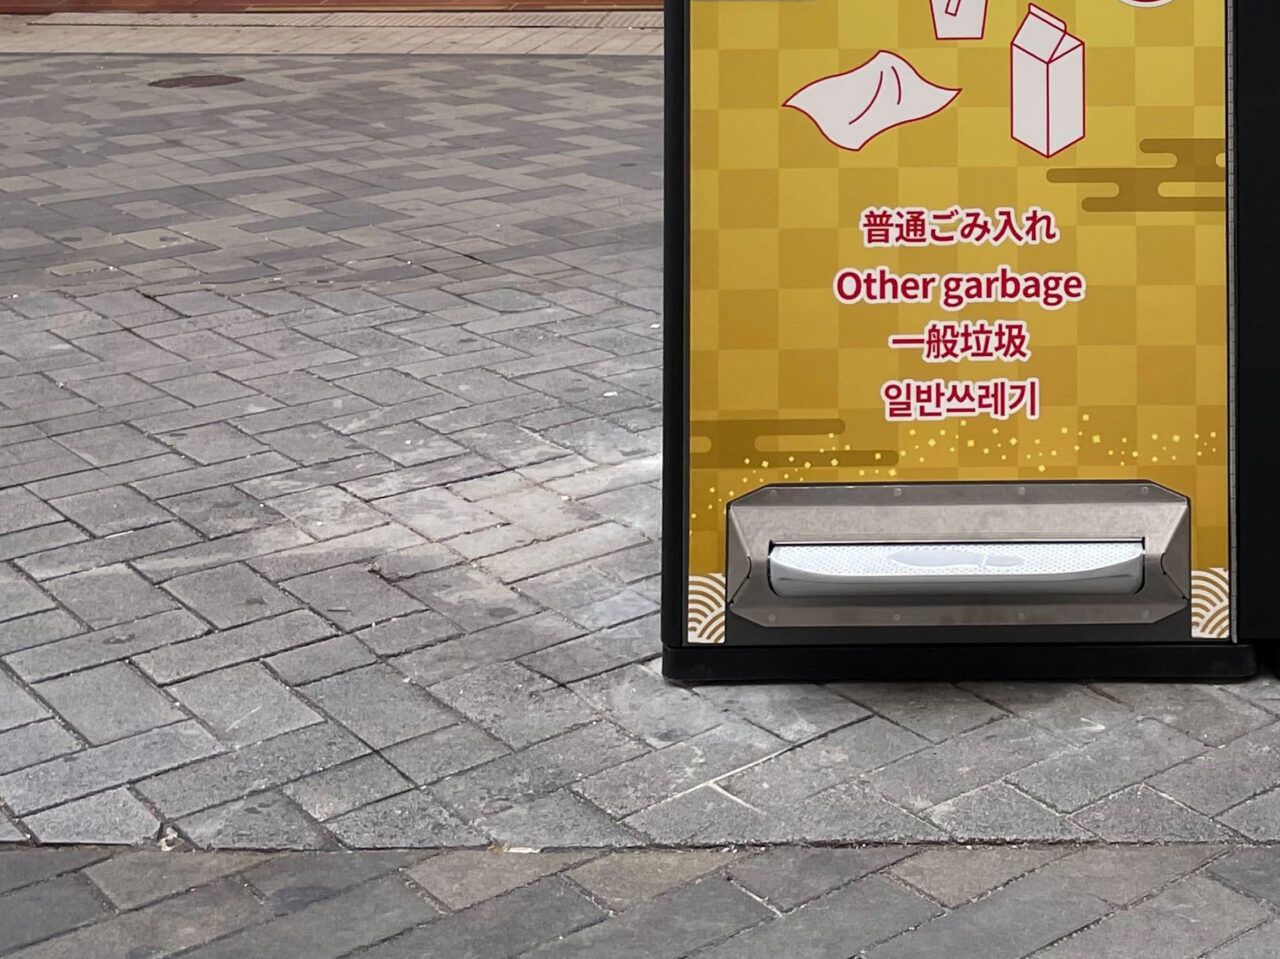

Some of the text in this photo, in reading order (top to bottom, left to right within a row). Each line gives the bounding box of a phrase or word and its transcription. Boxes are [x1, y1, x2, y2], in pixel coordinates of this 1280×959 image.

[863, 210, 1056, 244] 普通ごみ入れ
[837, 268, 1082, 308] Other garbage
[892, 323, 1027, 359] 一般垃圾
[884, 381, 1036, 418] 일반쓰레기
